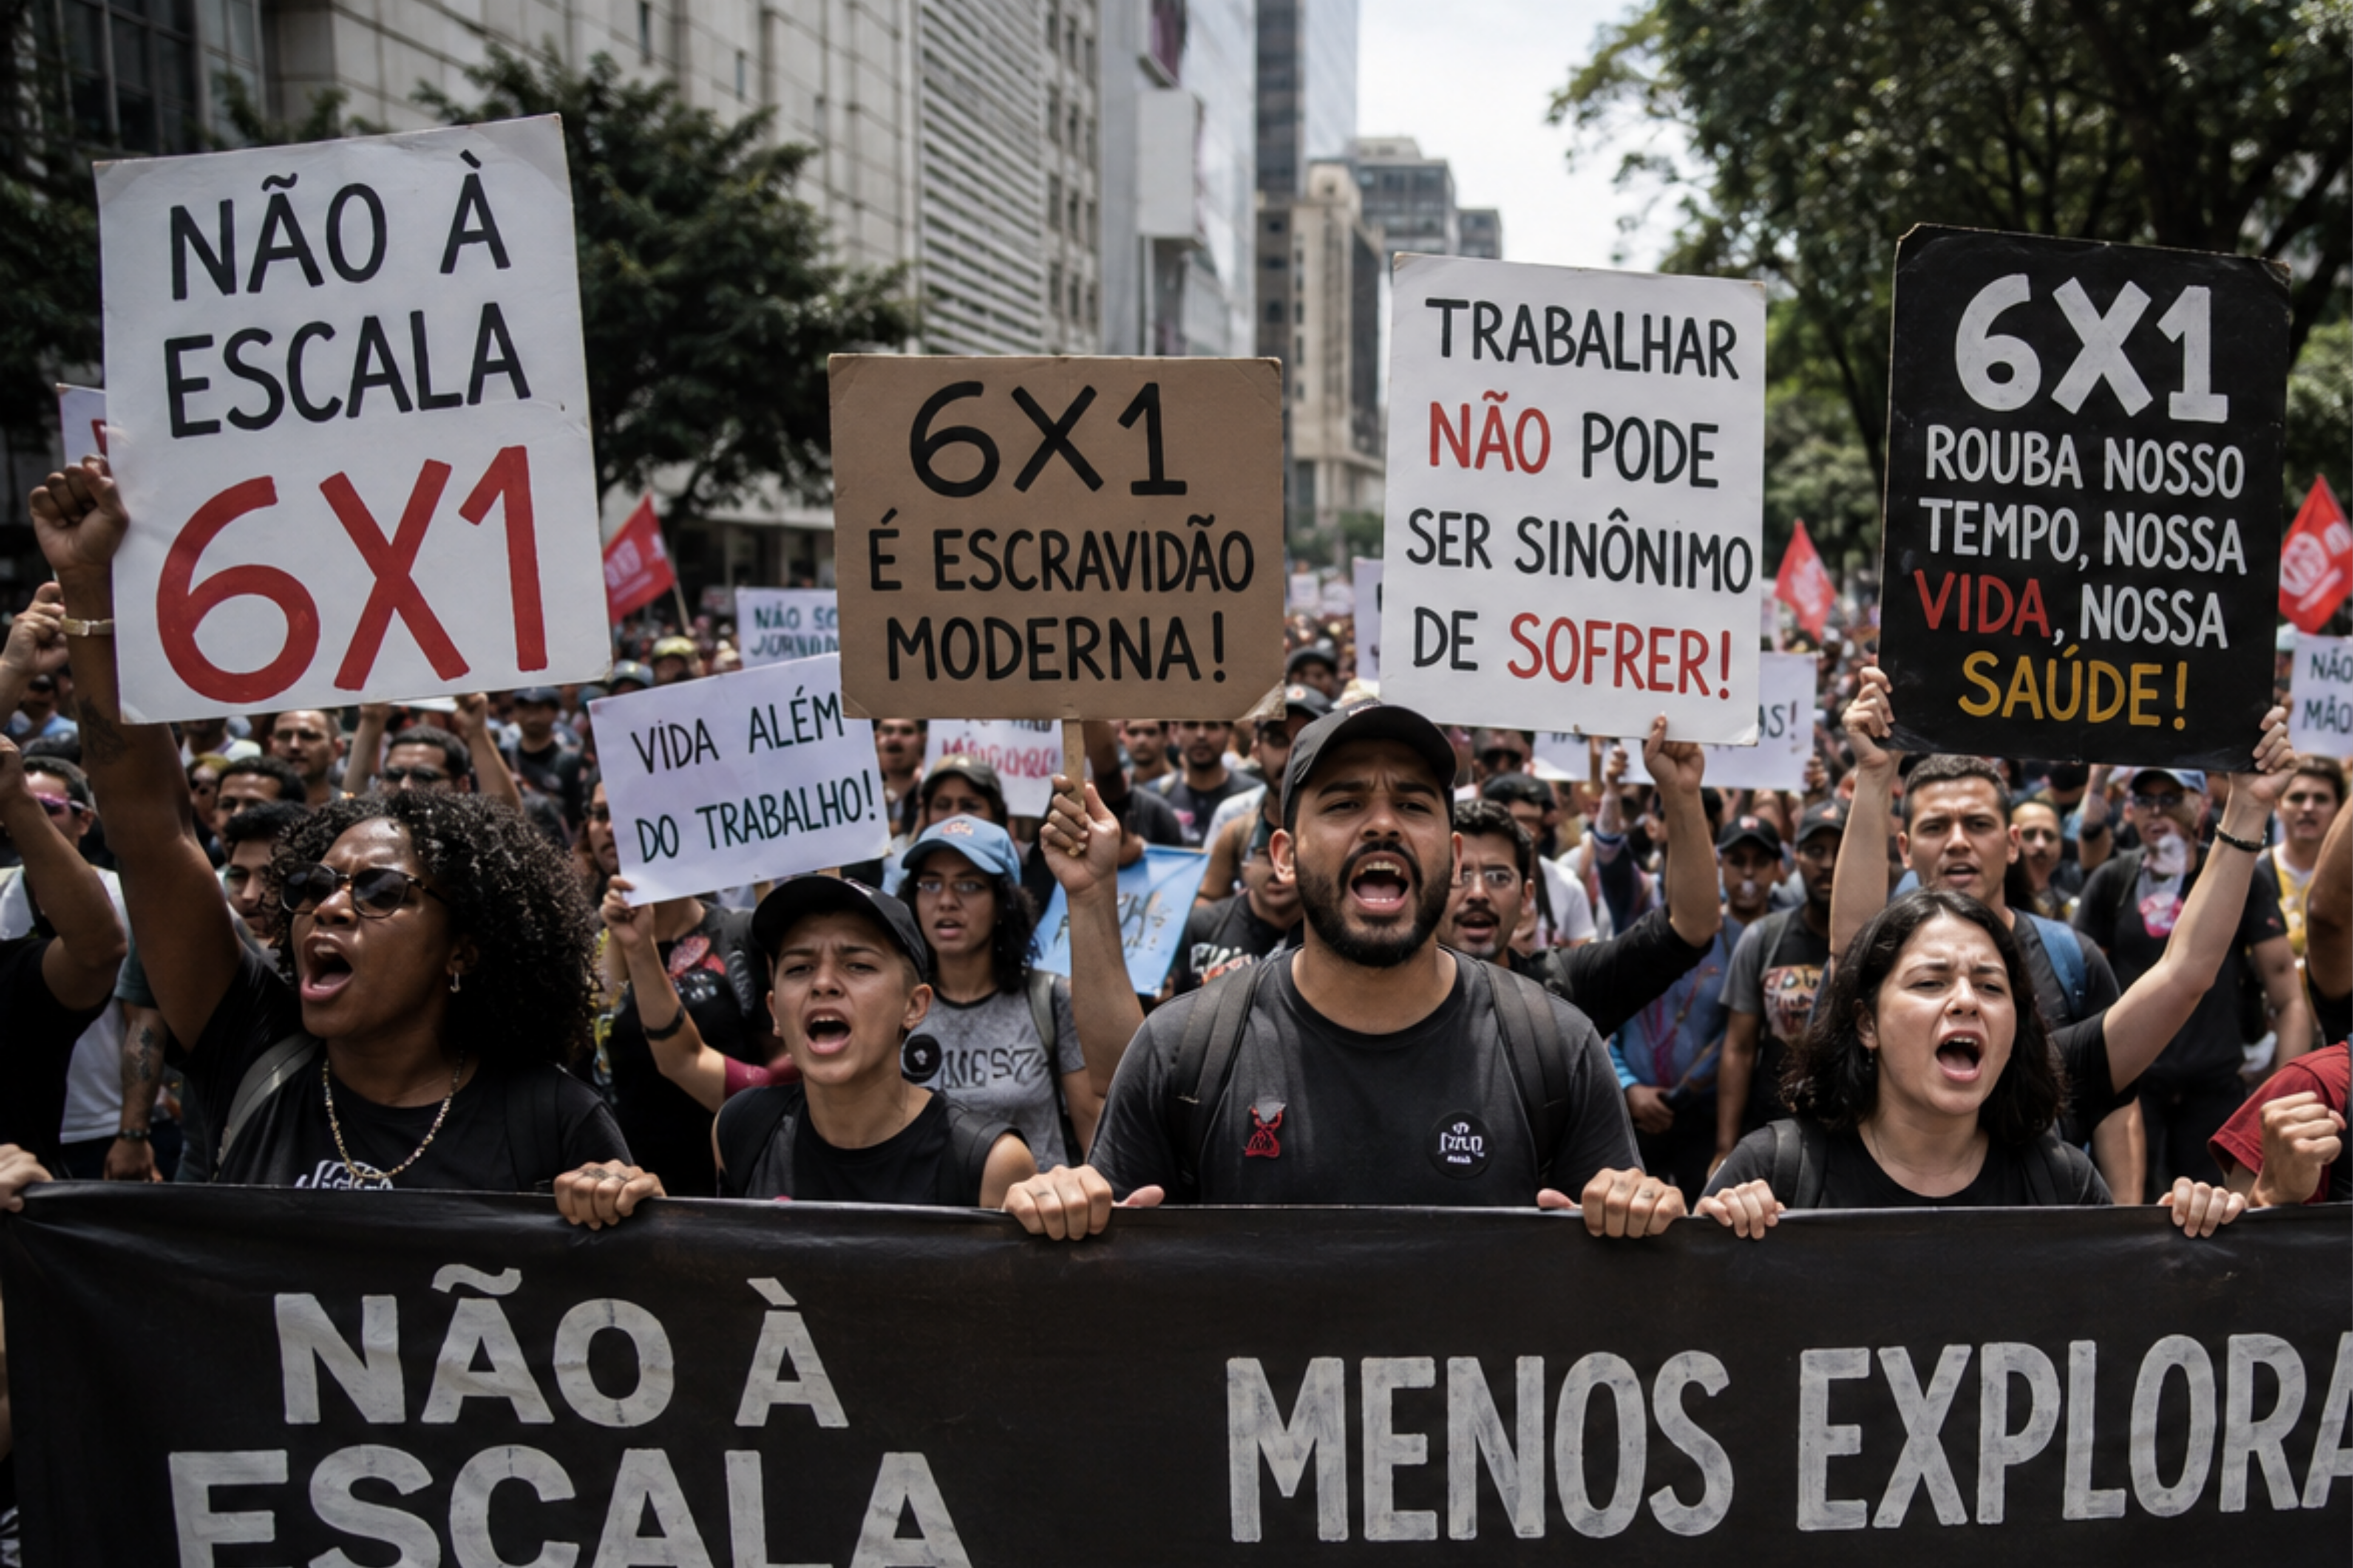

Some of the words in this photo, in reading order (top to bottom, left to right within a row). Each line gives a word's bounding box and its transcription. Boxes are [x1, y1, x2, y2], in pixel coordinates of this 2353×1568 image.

[170, 173, 386, 300] NÃO
[440, 150, 510, 273] À
[164, 303, 530, 439] ESCALA
[1426, 298, 1738, 379] TRABALHAR
[1956, 274, 2228, 423] 6X1
[910, 381, 1187, 498] 6X1
[1430, 391, 1550, 473] NÃO
[1583, 412, 1718, 488] PODE
[1927, 425, 2083, 489] ROUBA
[2105, 438, 2244, 498] NOSSO
[157, 446, 547, 703] 6X1
[869, 508, 902, 591] É
[933, 514, 1254, 592] ESCRAVIDÃO
[1407, 509, 1492, 569] SER
[1515, 508, 1752, 594] SINÔNIMO
[1919, 498, 2088, 570] TEMPO,
[2104, 511, 2246, 575] NOSSA
[887, 611, 1225, 682] MODERNA!
[1414, 607, 1478, 671] DE
[1508, 613, 1730, 699] SOFRER!
[1915, 570, 2064, 645] VIDA,
[2081, 584, 2228, 648] NOSSA
[748, 686, 843, 753] ALÉM
[1959, 645, 2188, 730] SAÚDE!
[636, 815, 679, 863] DO
[695, 770, 876, 849] TRABALHO!
[275, 1265, 673, 1426] NÃO
[735, 1278, 849, 1427] À
[1227, 1350, 1733, 1542] MENOS
[169, 1445, 972, 1568] ESCALA
